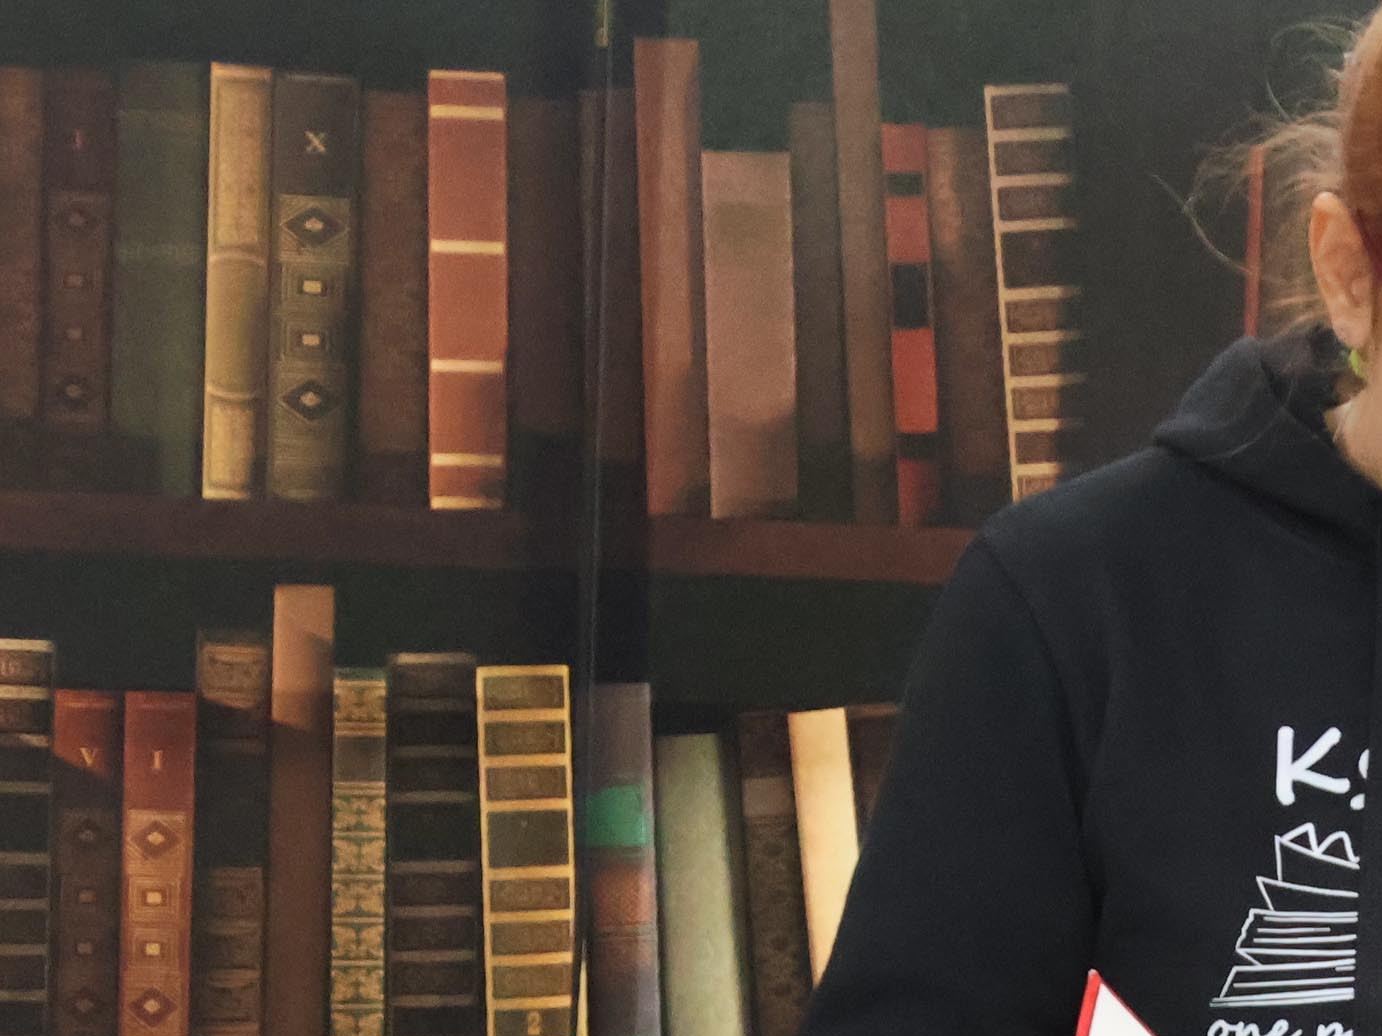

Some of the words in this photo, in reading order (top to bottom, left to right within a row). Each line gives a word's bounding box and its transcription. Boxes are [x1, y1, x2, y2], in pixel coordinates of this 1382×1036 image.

[305, 130, 327, 153] X
[79, 747, 97, 768] V
[525, 1010, 541, 1035] 2
